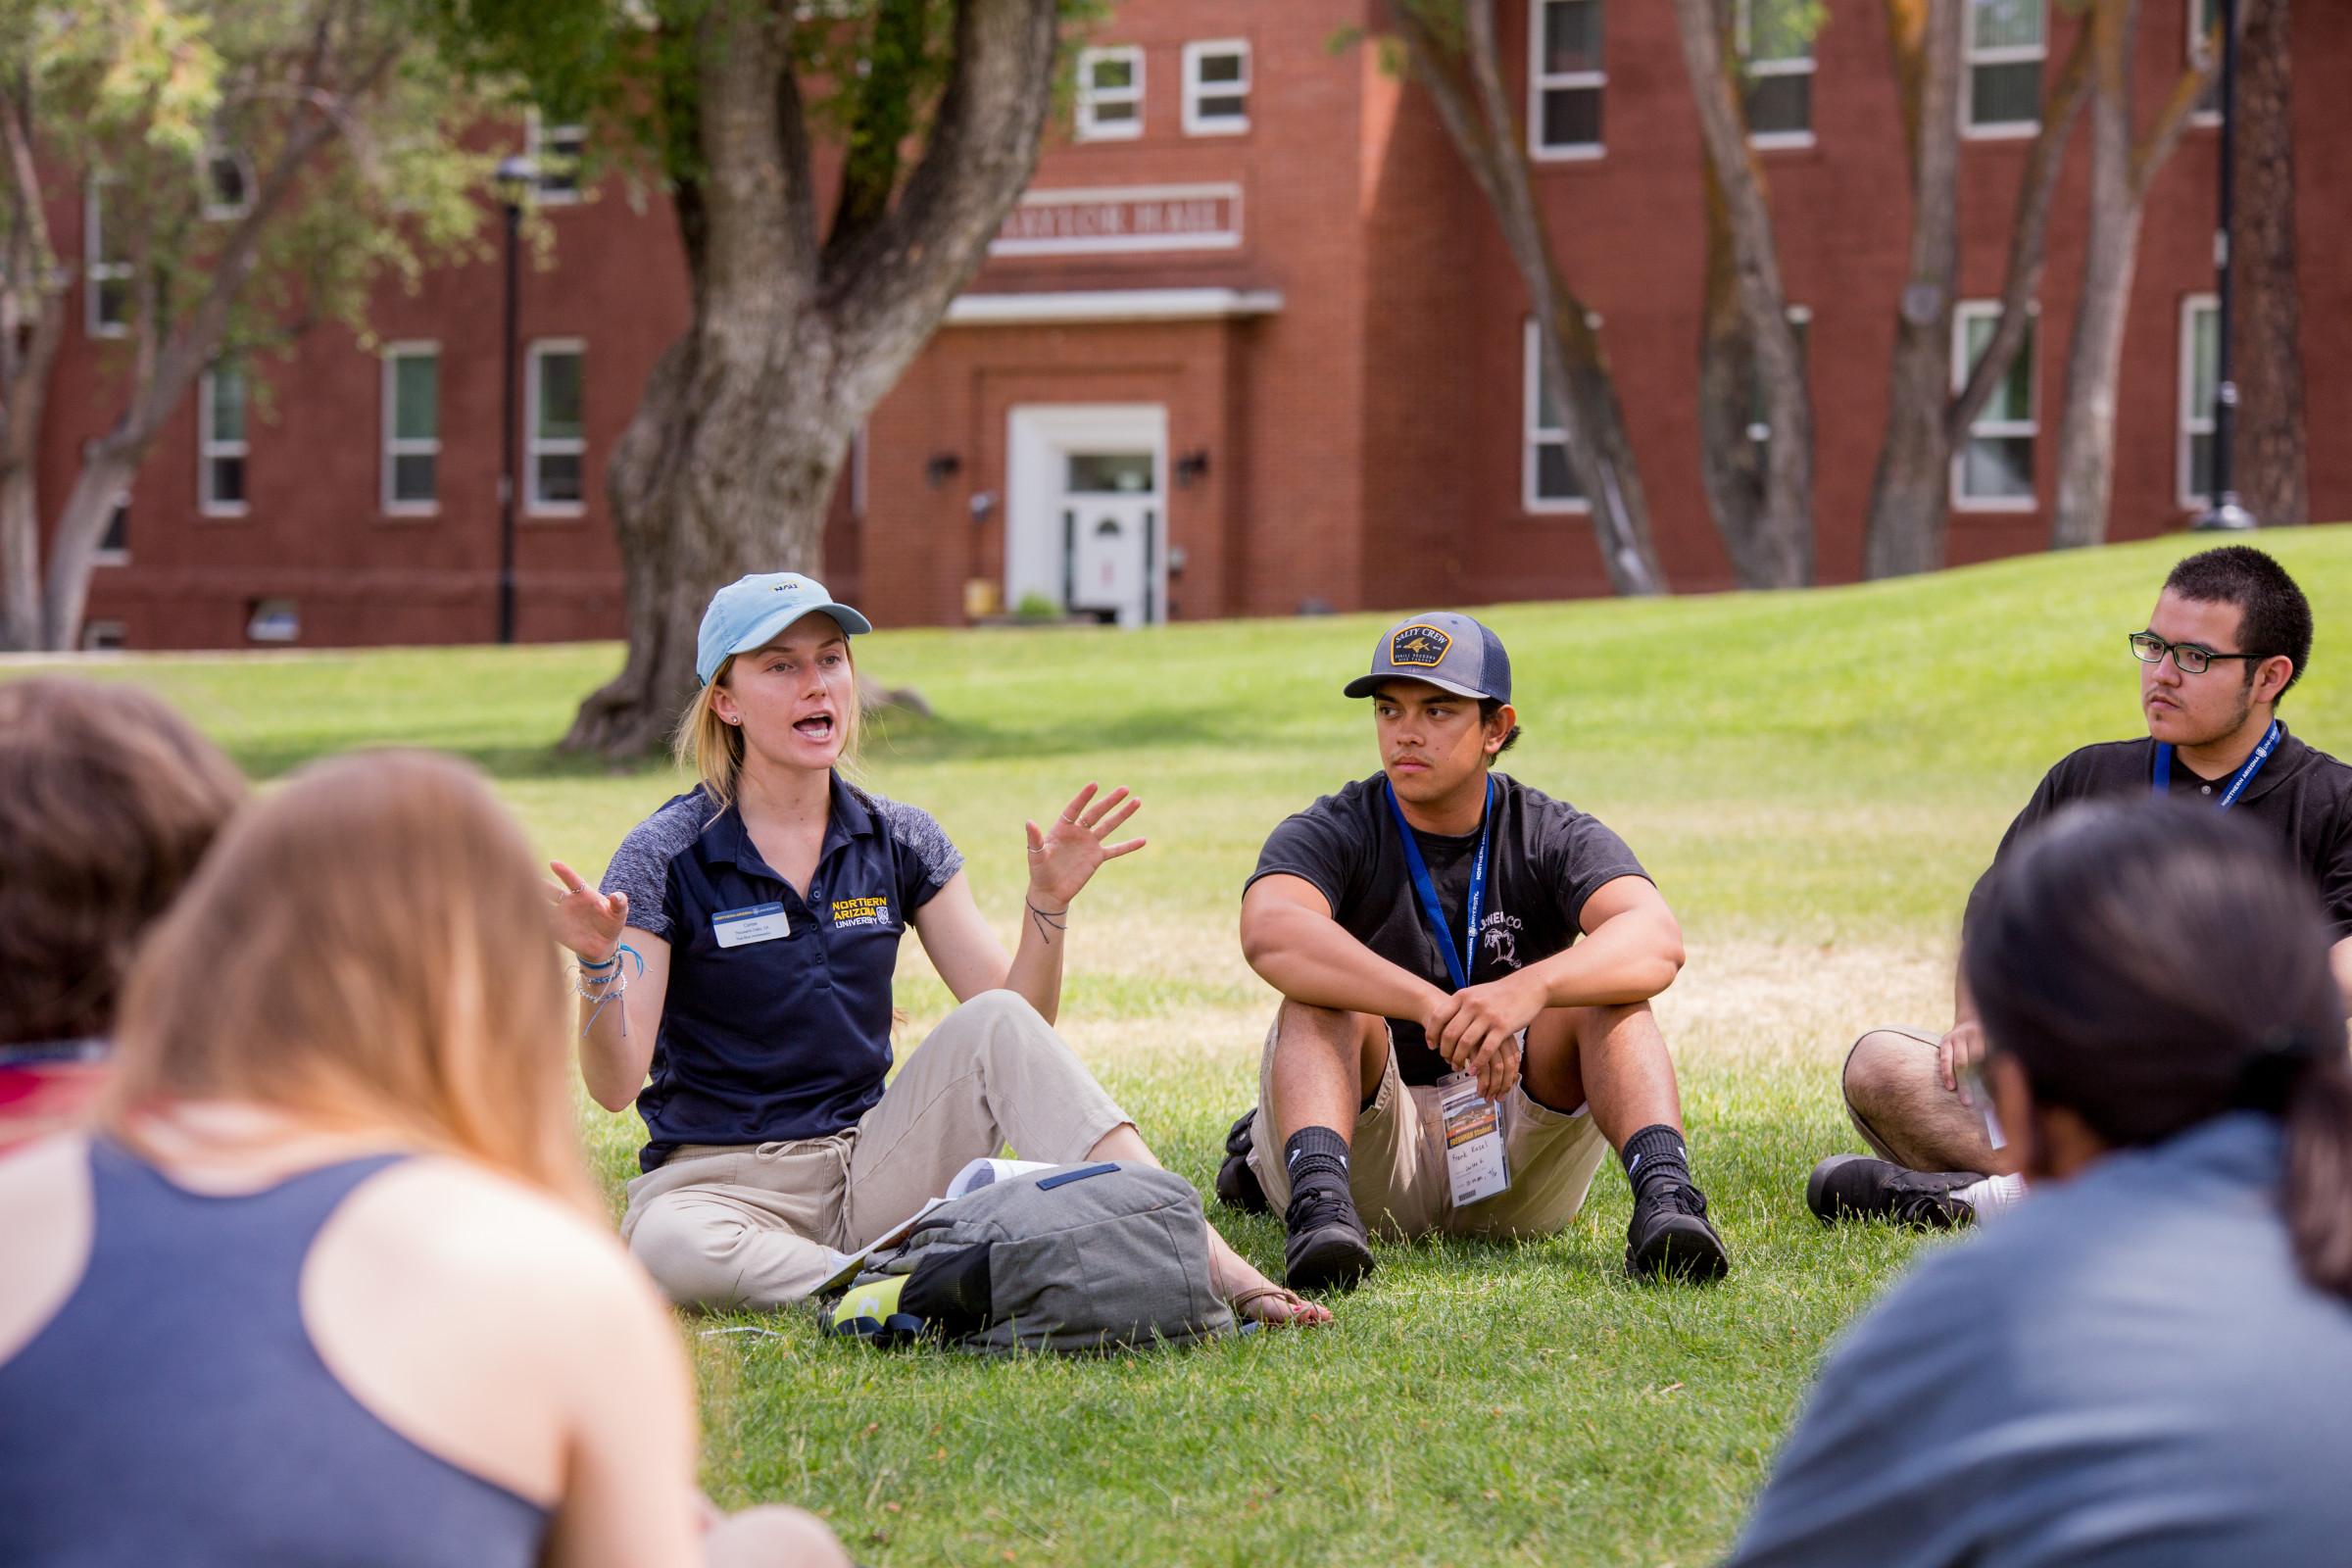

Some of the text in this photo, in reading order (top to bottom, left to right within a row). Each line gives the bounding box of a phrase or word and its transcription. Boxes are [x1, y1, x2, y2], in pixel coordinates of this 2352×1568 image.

[1396, 628, 1448, 644] SALTY CREW
[2221, 777, 2244, 807] NORTHERN
[2242, 756, 2261, 779] ARIZONA
[1476, 846, 1485, 880] NORTHERN
[1450, 1124, 1492, 1147] FRESHMAN Student
[1451, 1151, 1468, 1162] Frank
